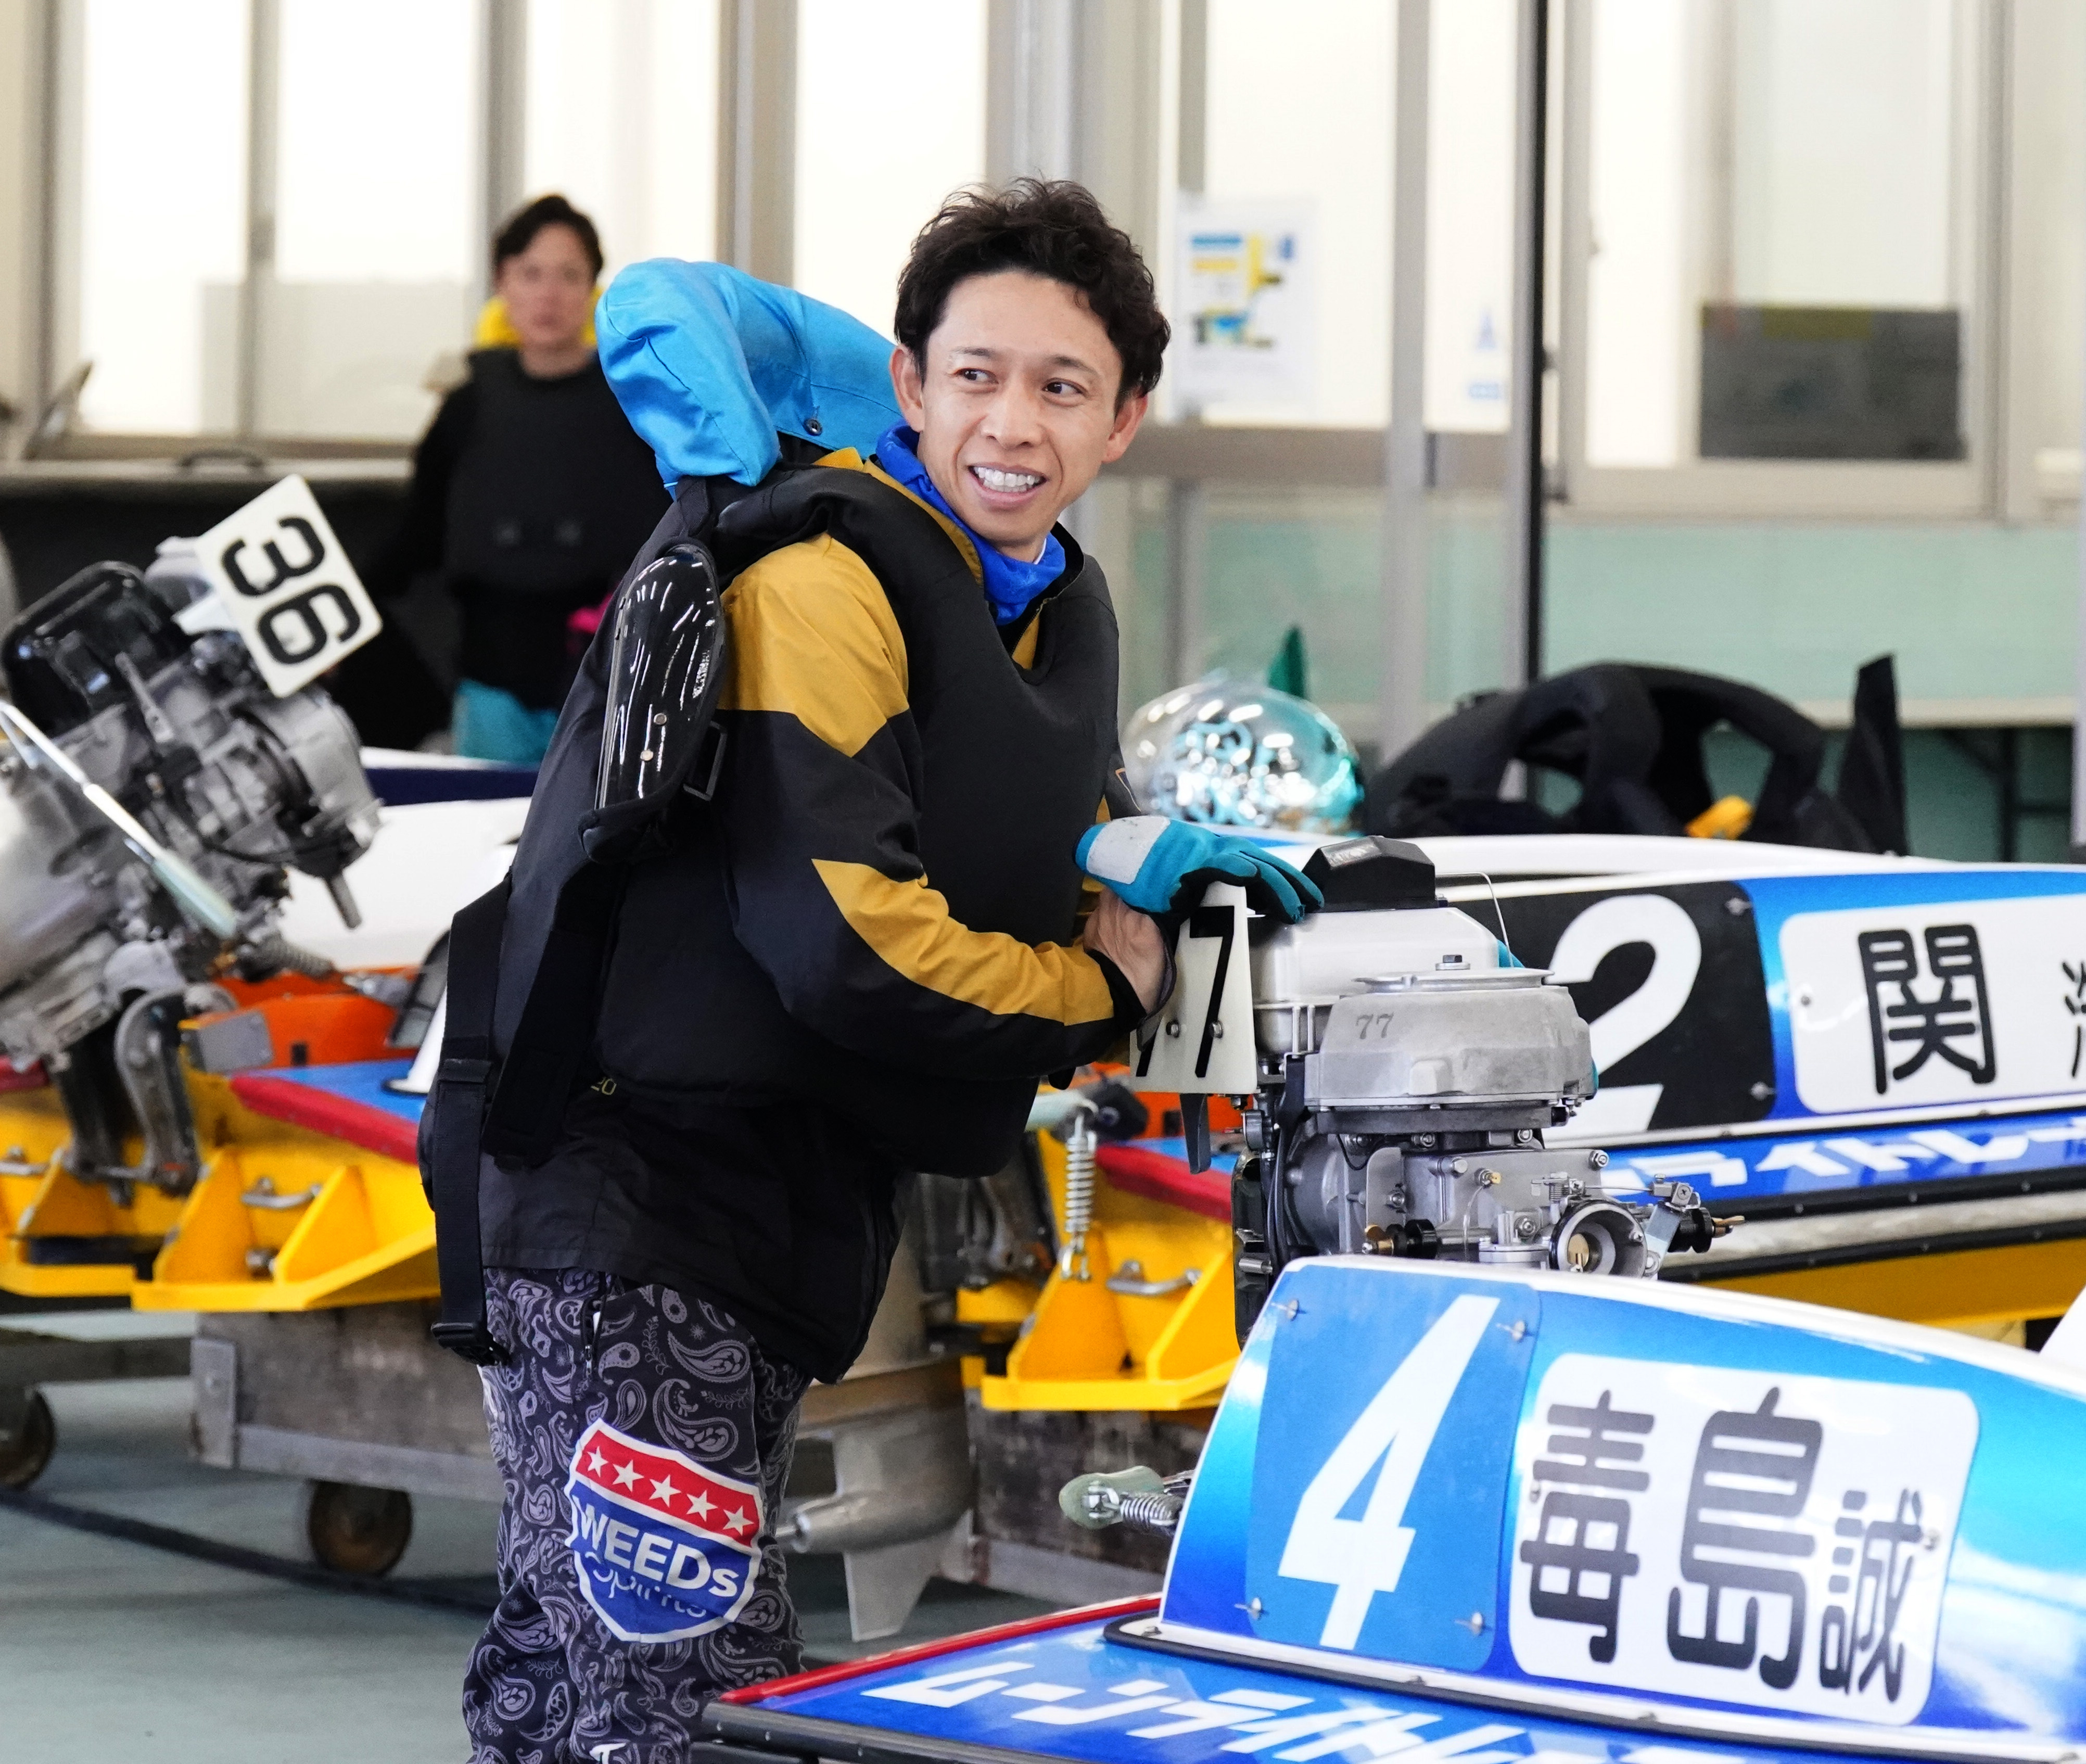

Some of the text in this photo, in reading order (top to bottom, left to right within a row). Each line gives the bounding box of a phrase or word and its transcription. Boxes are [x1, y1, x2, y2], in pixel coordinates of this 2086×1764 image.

[222, 516, 361, 666] 36
[1136, 906, 1235, 1078] 7
[1355, 1012, 1394, 1039] 77
[1544, 894, 1702, 1134] 2
[573, 1495, 739, 1597] WEEDs
[1277, 1294, 1501, 1651] 4
[1520, 1387, 1922, 1704] 毒島誠
